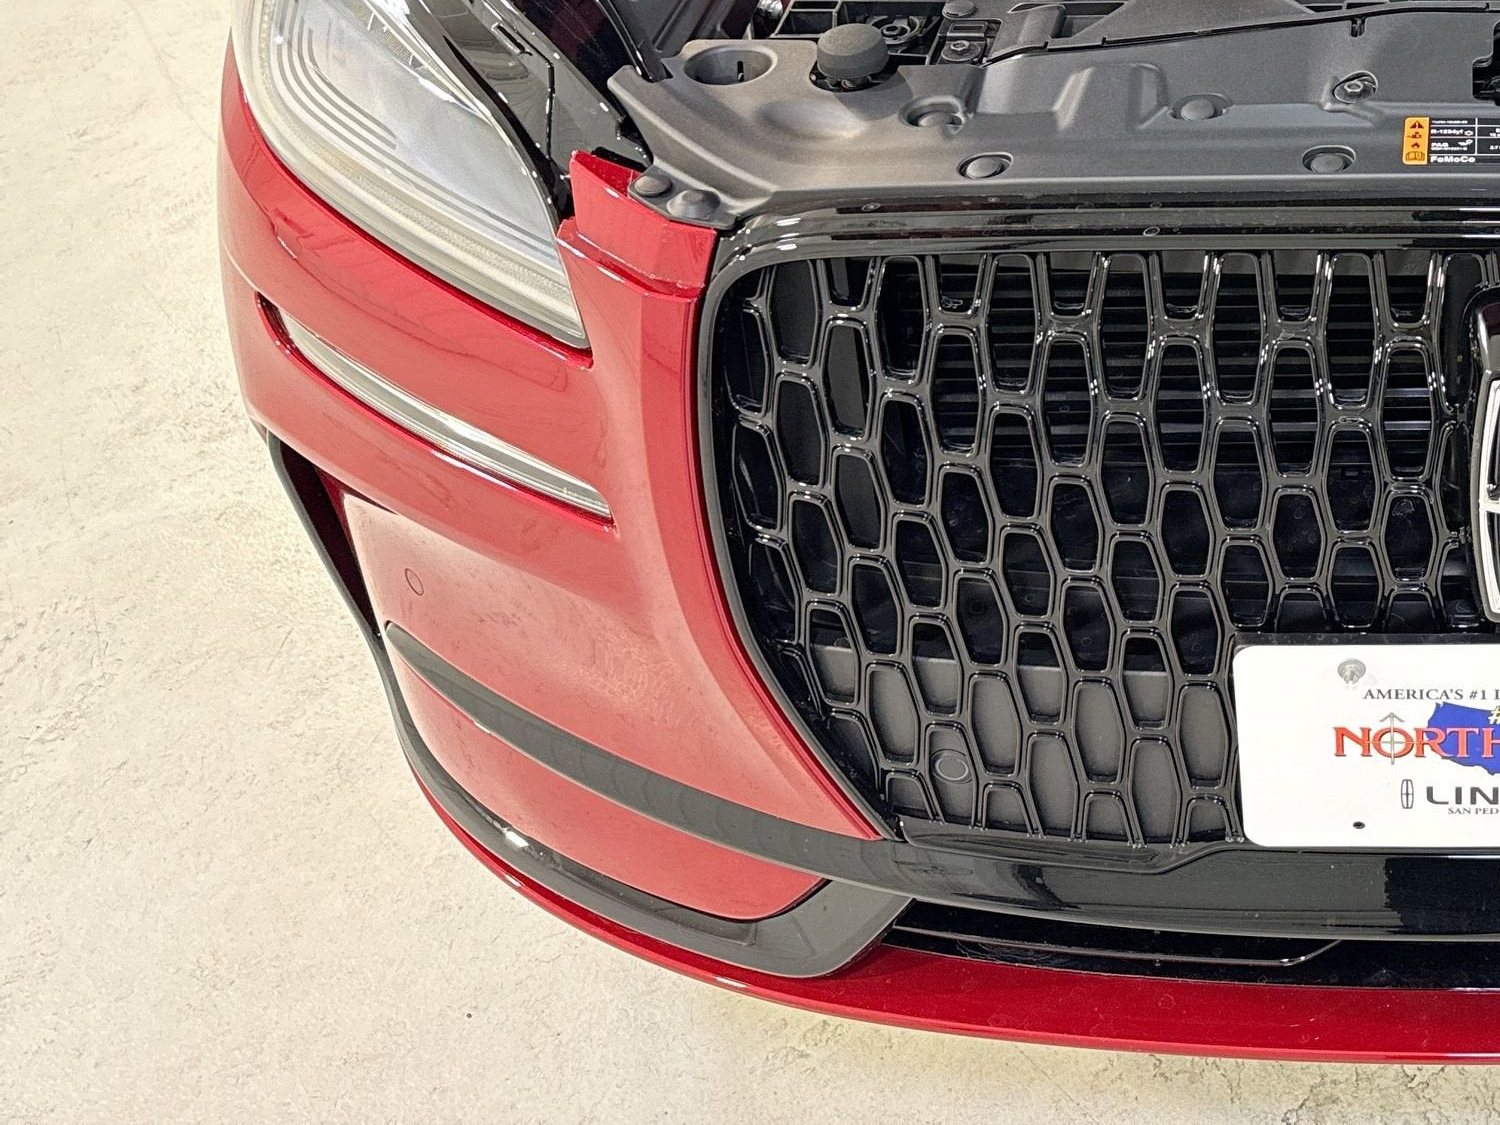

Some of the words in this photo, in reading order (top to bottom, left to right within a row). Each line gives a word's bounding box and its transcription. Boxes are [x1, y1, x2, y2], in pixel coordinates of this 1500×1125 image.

[1362, 688, 1464, 700] AMERICA'S
[1469, 688, 1486, 700] #1
[1447, 807, 1471, 815] SAN
